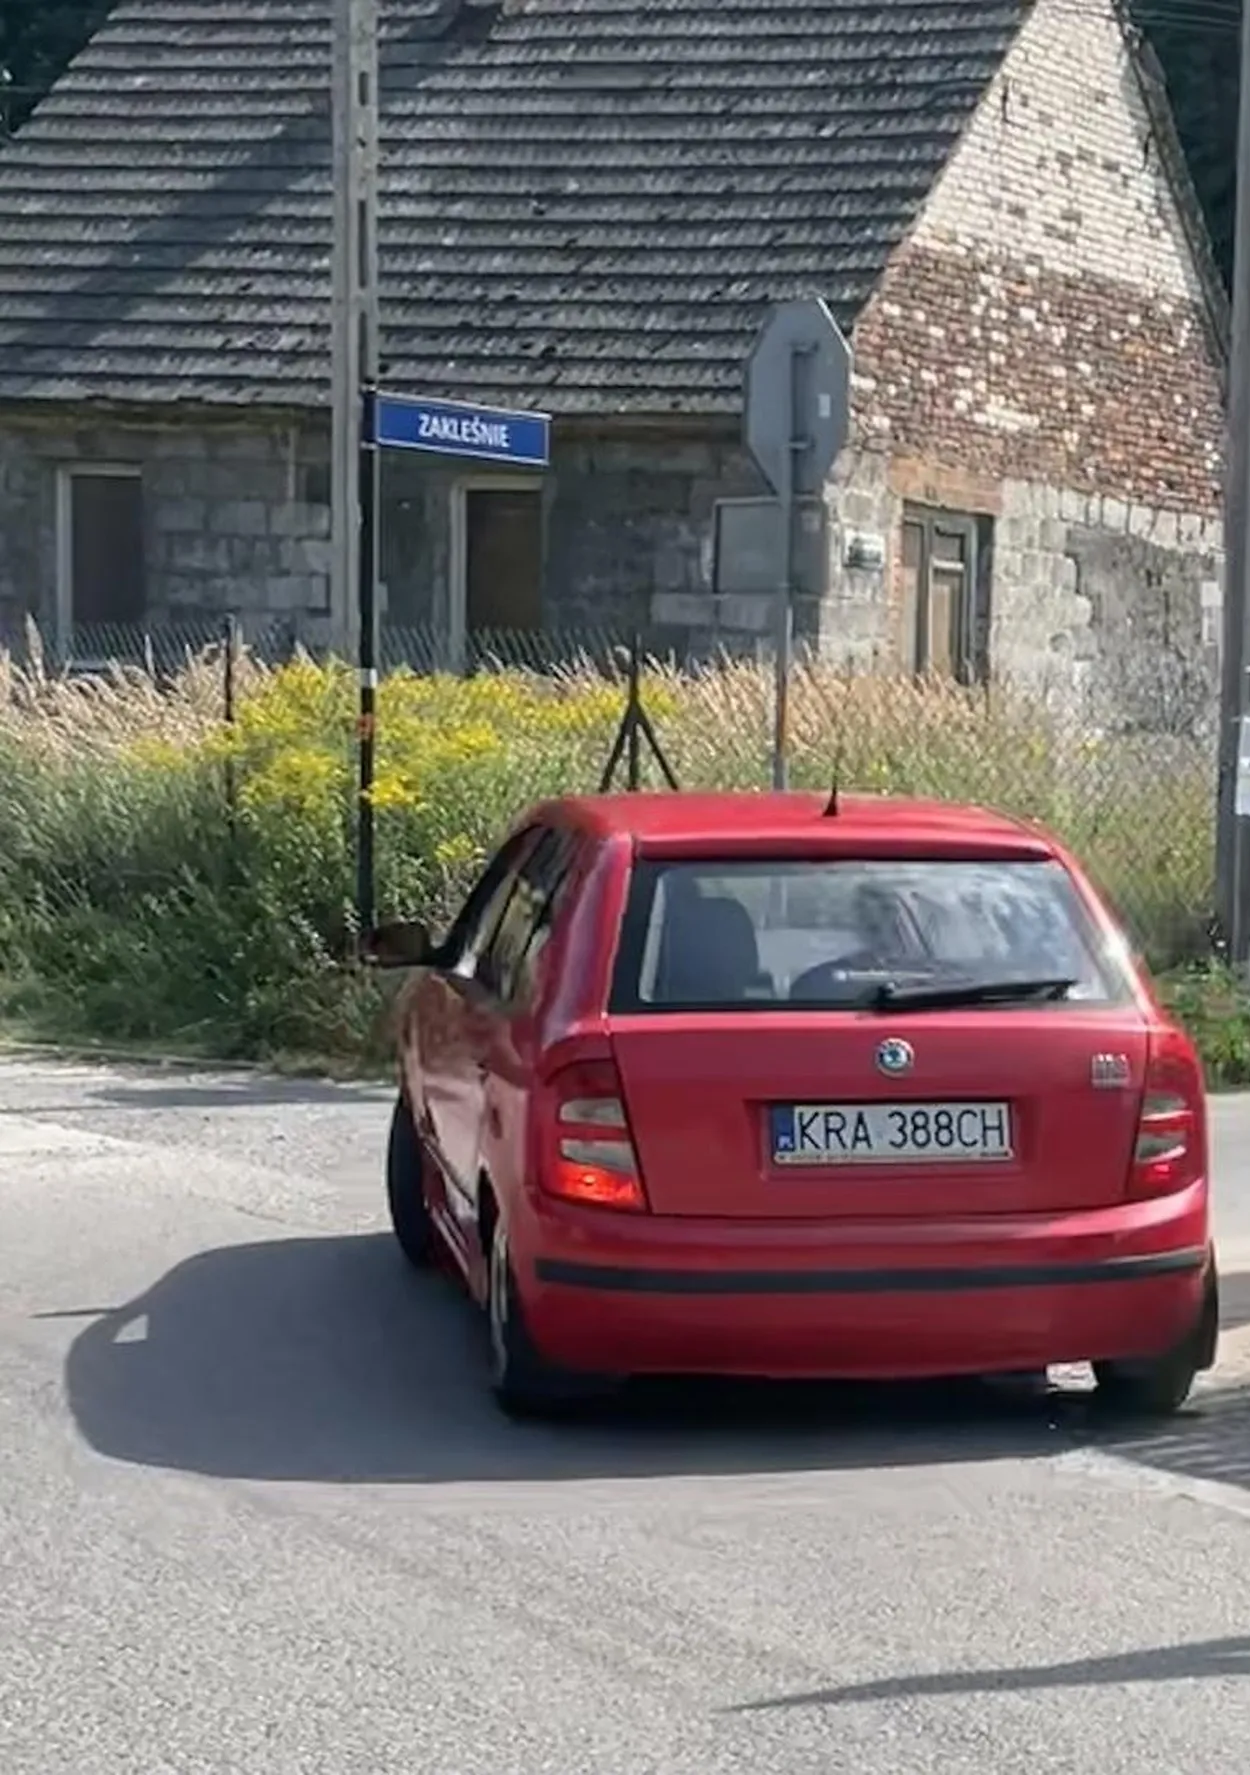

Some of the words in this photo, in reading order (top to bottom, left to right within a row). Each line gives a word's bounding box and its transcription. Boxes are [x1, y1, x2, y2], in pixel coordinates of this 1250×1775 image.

[418, 412, 511, 448] ZAKLEŚNIE
[798, 1111, 873, 1150] KRA
[888, 1108, 1005, 1149] 388CH
